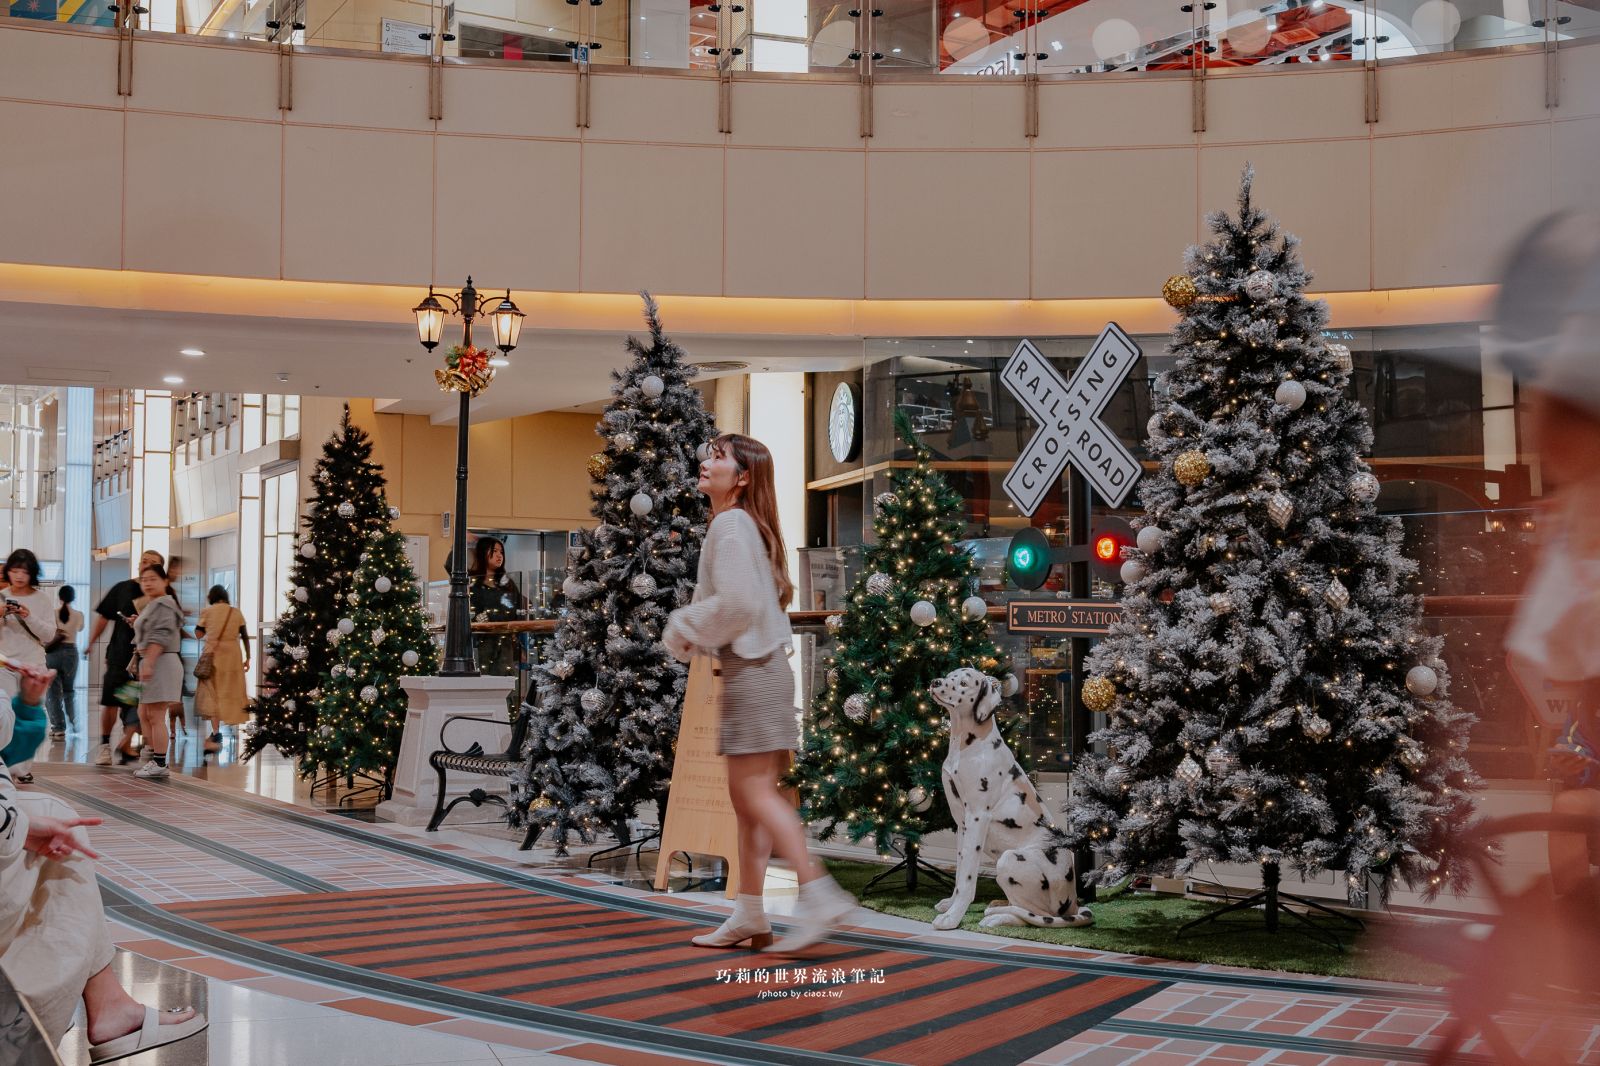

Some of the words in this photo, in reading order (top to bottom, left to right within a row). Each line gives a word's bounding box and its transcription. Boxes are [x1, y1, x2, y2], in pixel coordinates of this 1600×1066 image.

[385, 23, 391, 31] 5
[1014, 360, 1061, 418] RAIL
[1076, 430, 1125, 487] ROAD
[1021, 350, 1118, 490] CROSSING
[1027, 610, 1067, 624] METRO
[1071, 611, 1121, 625] STATION
